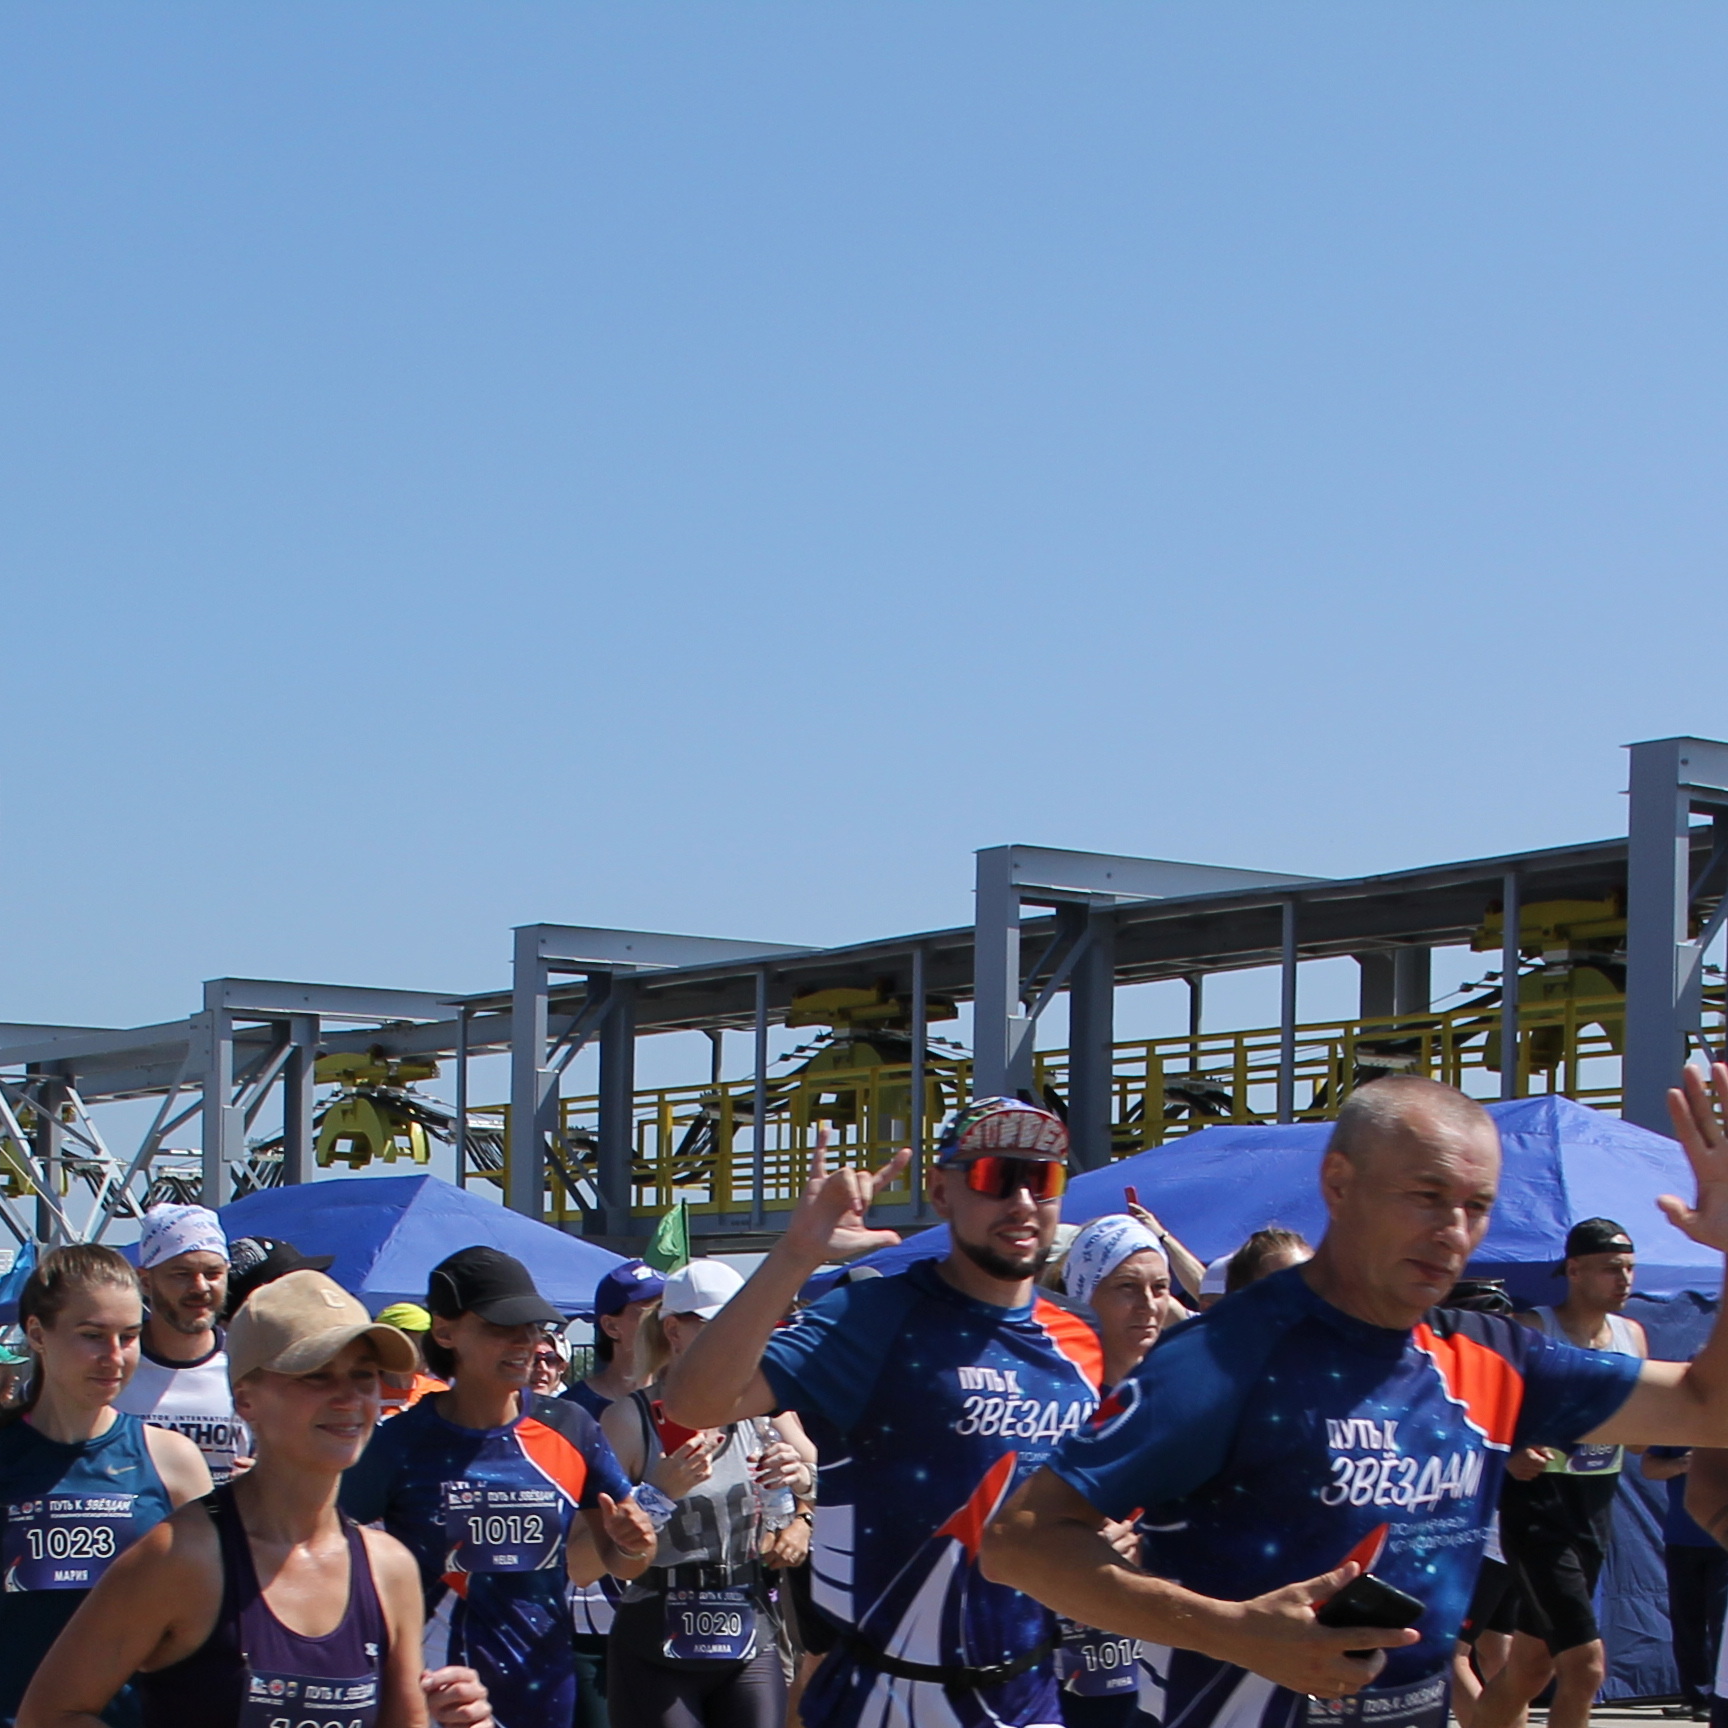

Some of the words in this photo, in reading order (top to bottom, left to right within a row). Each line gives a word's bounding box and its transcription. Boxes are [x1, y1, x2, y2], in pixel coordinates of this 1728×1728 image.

[957, 1366, 1006, 1392] ПУТЬ
[1325, 1418, 1383, 1450] ПУТЬ
[1320, 1450, 1485, 1514] ЗВЁЗДАМ
[50, 1500, 73, 1511] ПУТЬ
[27, 1526, 116, 1560] 1023
[468, 1514, 544, 1545] 1012
[54, 1570, 88, 1581] МАРИЯ
[682, 1611, 742, 1636] 1020
